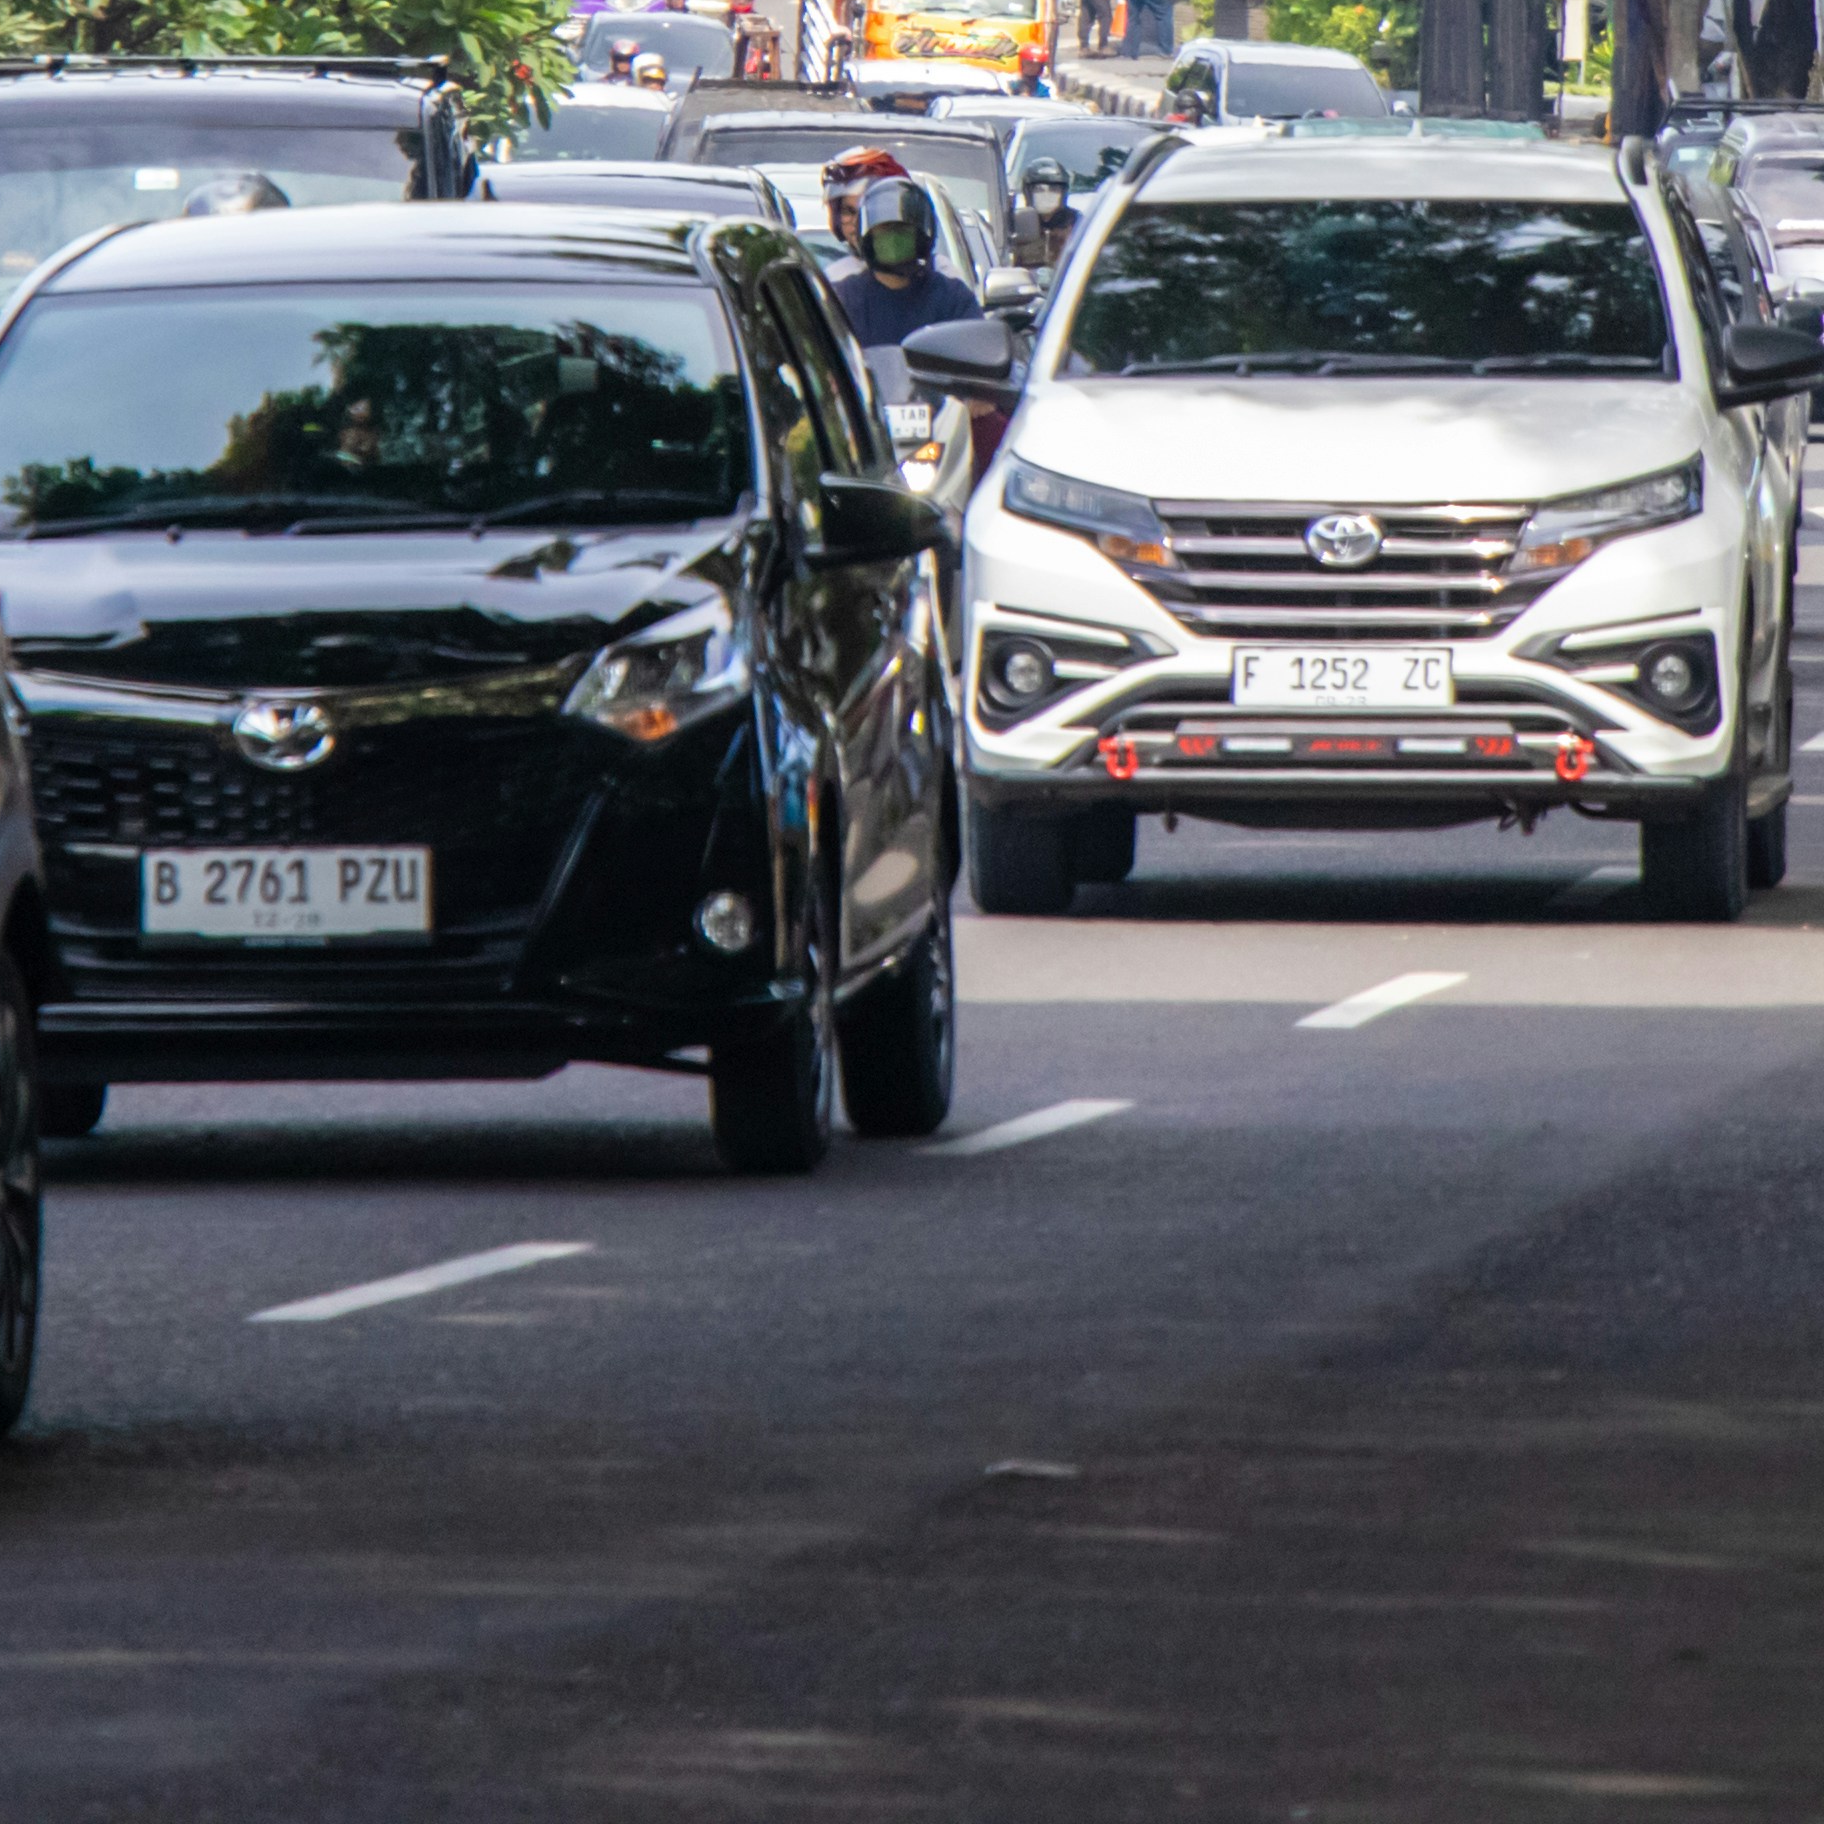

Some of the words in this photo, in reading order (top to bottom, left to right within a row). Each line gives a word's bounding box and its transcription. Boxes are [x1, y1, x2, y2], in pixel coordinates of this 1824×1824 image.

[1243, 655, 1260, 689] F
[1288, 656, 1369, 691] 1252
[1402, 657, 1441, 691] ZC
[153, 860, 180, 905] B
[203, 858, 309, 905] 2761
[336, 857, 419, 904] PZU
